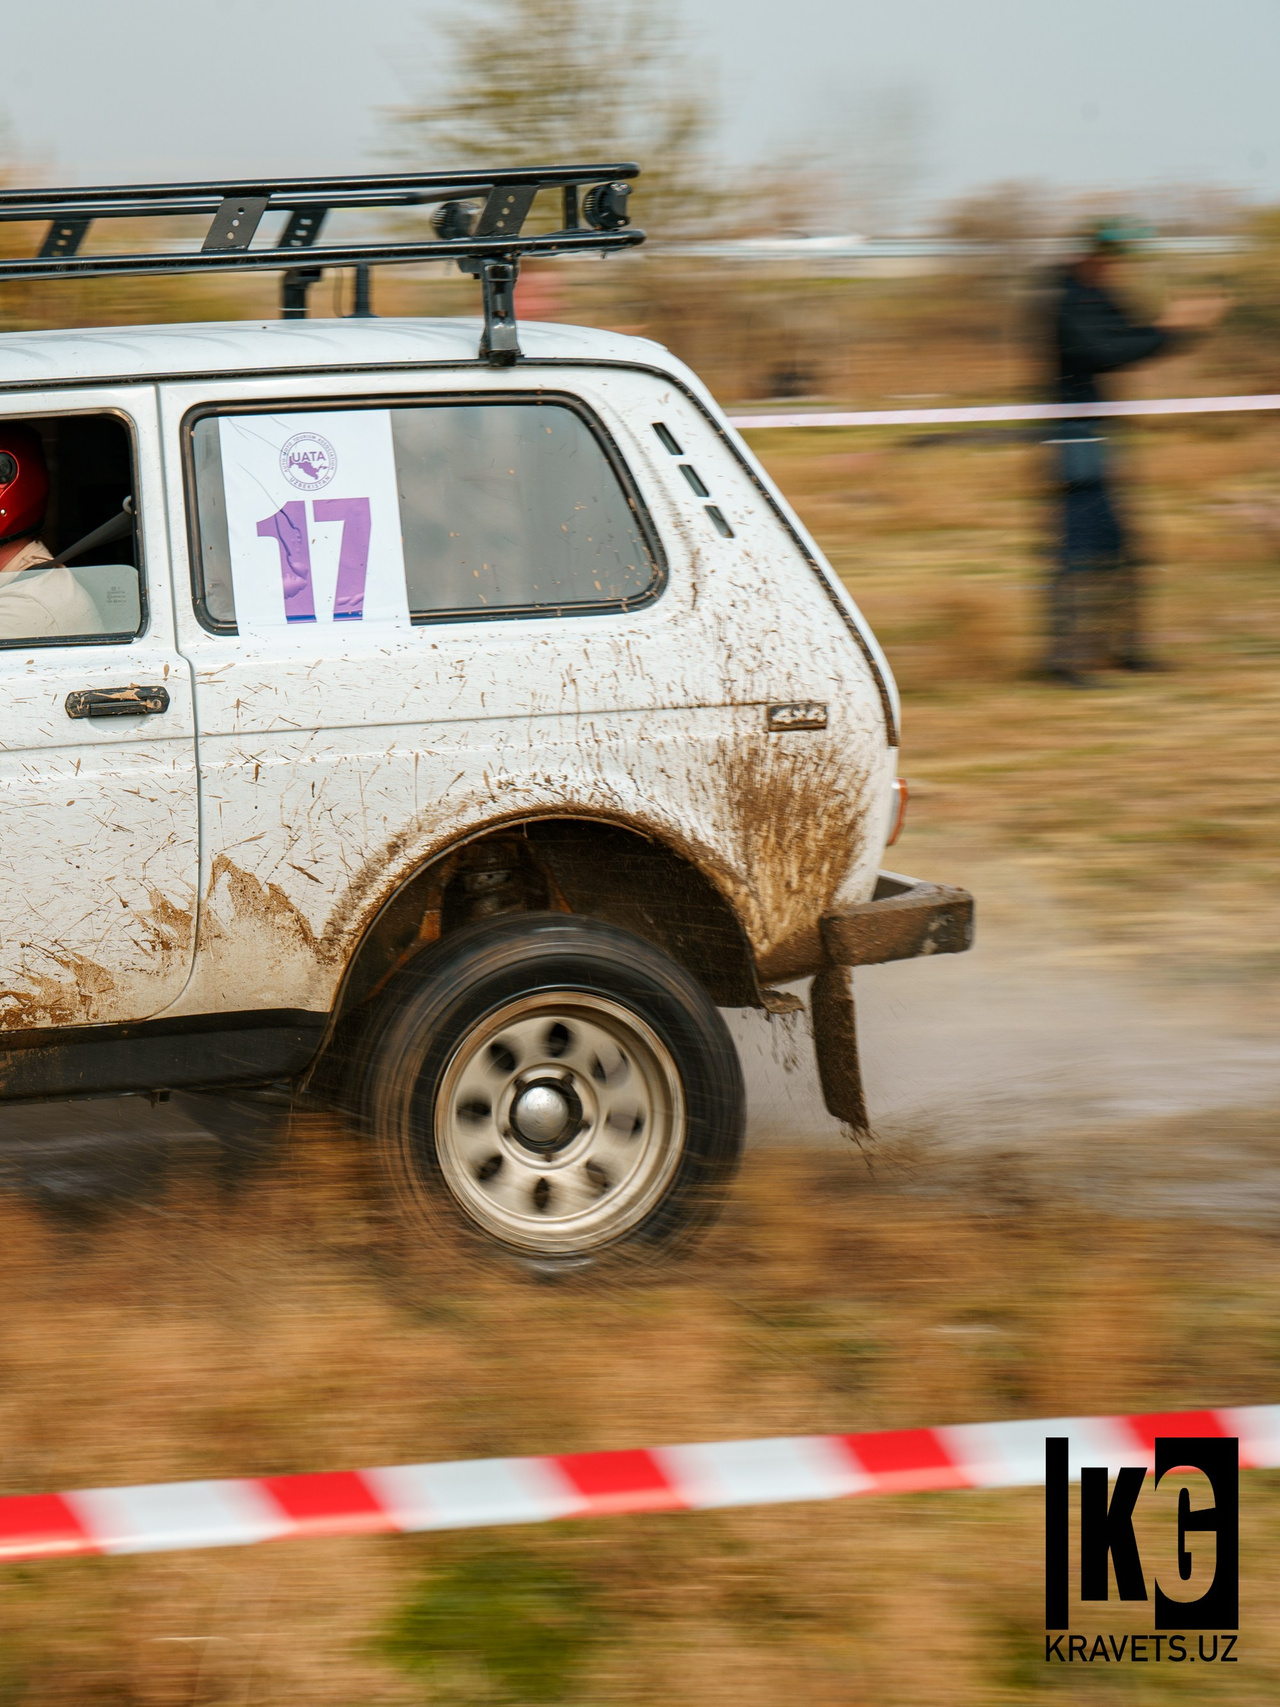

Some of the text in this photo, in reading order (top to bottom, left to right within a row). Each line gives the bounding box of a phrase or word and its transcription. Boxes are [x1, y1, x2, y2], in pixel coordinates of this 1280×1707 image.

[292, 434, 316, 442] TOURISM
[317, 438, 334, 470] ASSOCIATION
[292, 451, 326, 462] UATA
[289, 476, 330, 489] UZBEKISTAN
[256, 497, 372, 624] 17
